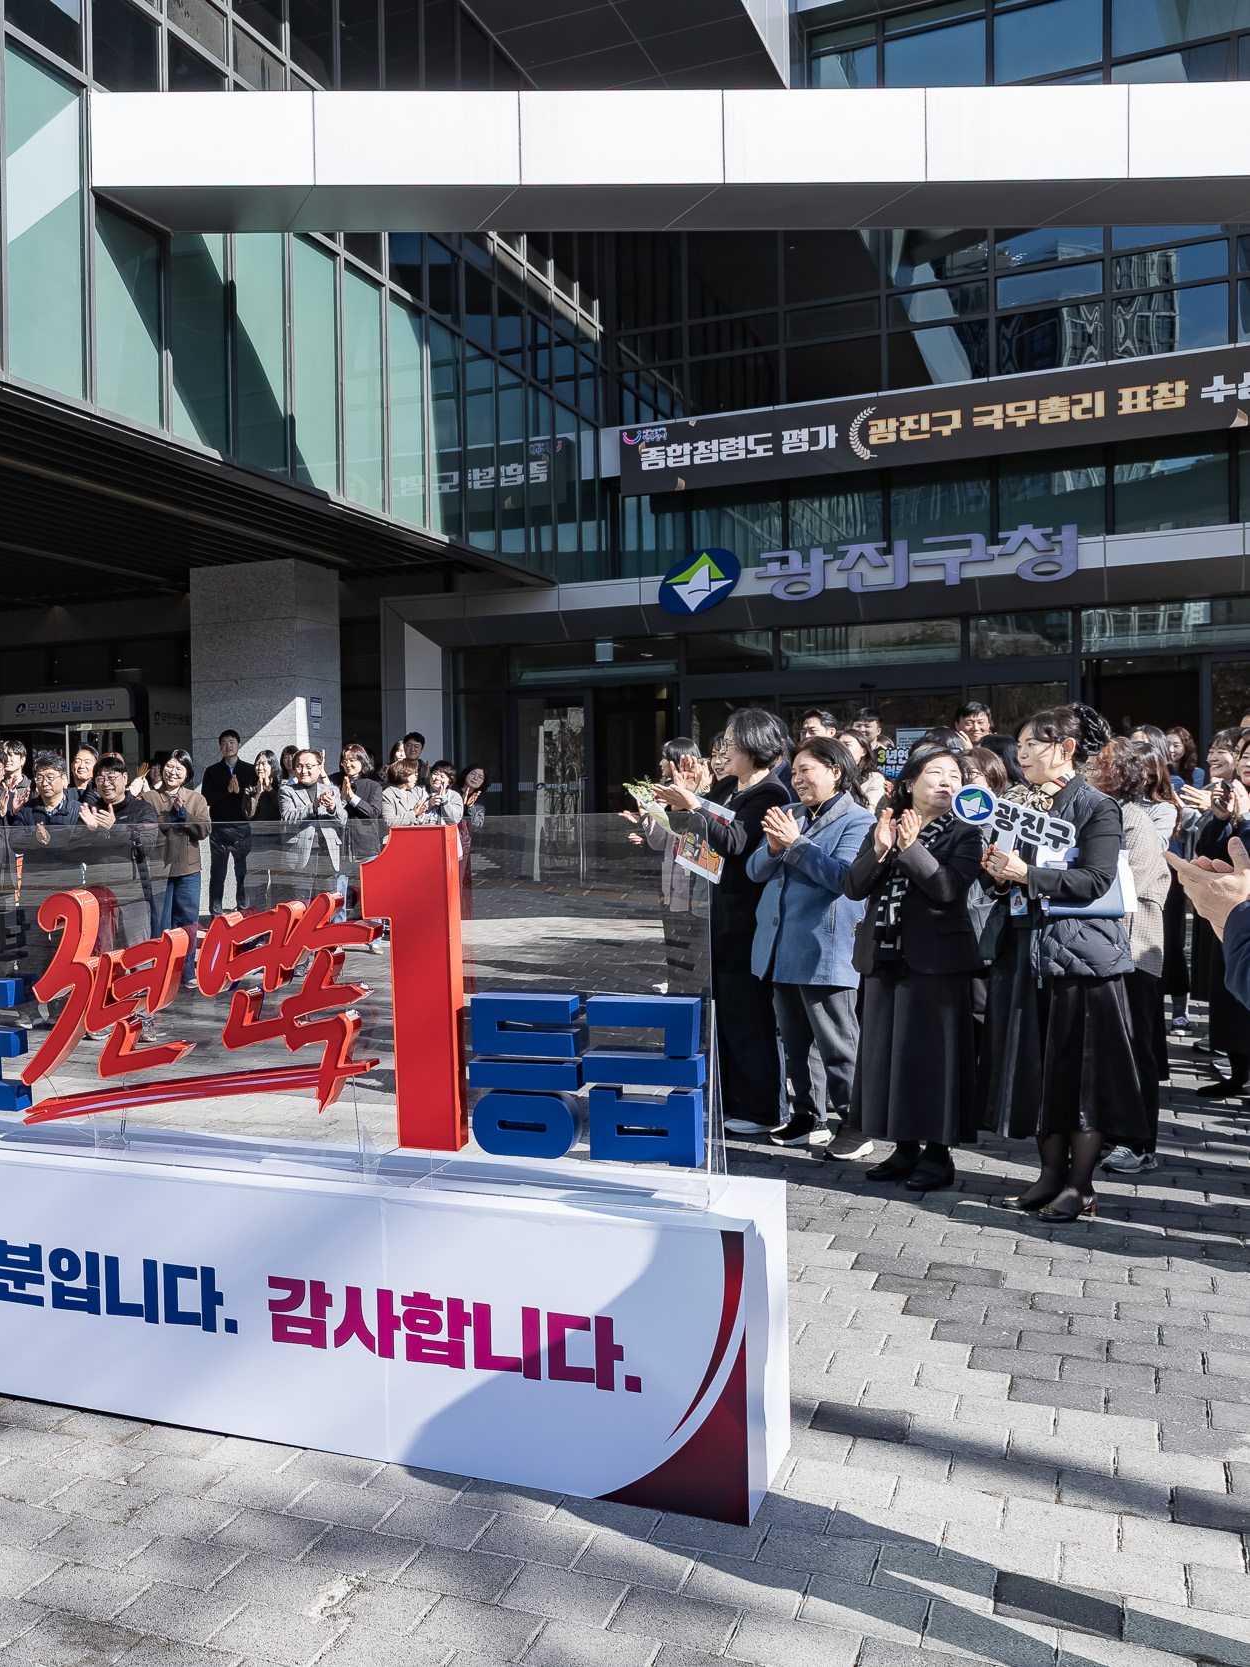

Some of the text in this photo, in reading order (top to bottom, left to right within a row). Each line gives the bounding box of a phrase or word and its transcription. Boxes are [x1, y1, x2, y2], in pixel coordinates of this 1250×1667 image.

[640, 432, 774, 471] 종합청렴도
[781, 424, 838, 456] 평가
[867, 409, 963, 446] 광진구
[972, 390, 1106, 431] 국무총리
[1117, 380, 1190, 415] 표창
[754, 523, 1079, 600] 광진구청
[28, 698, 116, 715] 무인민원발급창구
[995, 802, 1071, 849] 광진구
[20, 889, 196, 1086] 3년
[197, 890, 384, 1114] 연속
[267, 1275, 642, 1393] 감사합니다.
